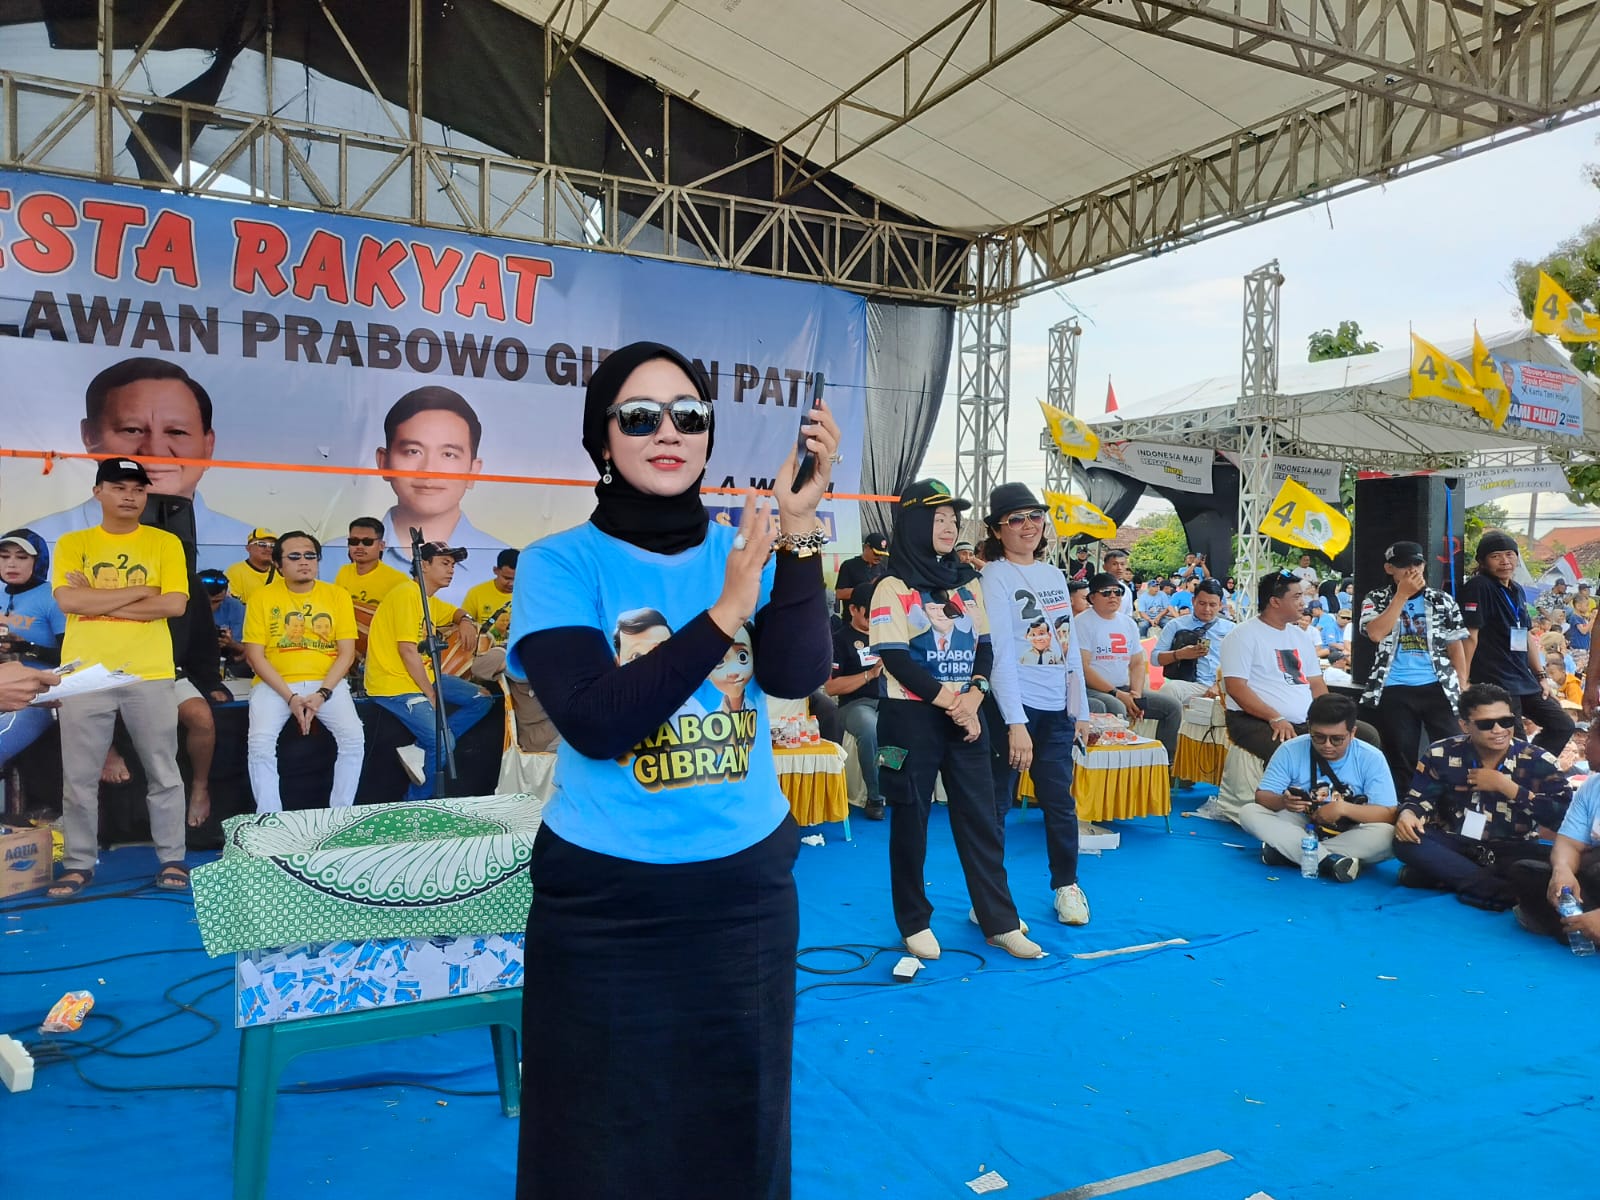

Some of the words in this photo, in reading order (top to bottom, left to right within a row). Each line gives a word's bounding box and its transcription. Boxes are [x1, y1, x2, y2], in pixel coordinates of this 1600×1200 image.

[0, 190, 198, 289] STA
[232, 218, 553, 325] RAKYAT
[1543, 294, 1558, 320] 4
[0, 291, 219, 356] AWAN
[242, 310, 529, 381] PRABOWO
[1418, 355, 1438, 380] 4
[1533, 407, 1558, 424] PILIH
[1559, 412, 1566, 425] 2
[1137, 449, 1180, 460] INDONESIA
[1183, 455, 1203, 464] MAJU
[1274, 463, 1312, 473] INDONESIA
[1313, 467, 1332, 476] MAJU
[1274, 501, 1297, 527] 4
[117, 553, 129, 569] 2
[360, 590, 367, 601] 2
[1014, 589, 1043, 619] 2
[303, 604, 313, 617] 2
[1408, 602, 1415, 610] 2
[633, 743, 750, 785] GIBRAN
[5, 843, 38, 861] AQUA
